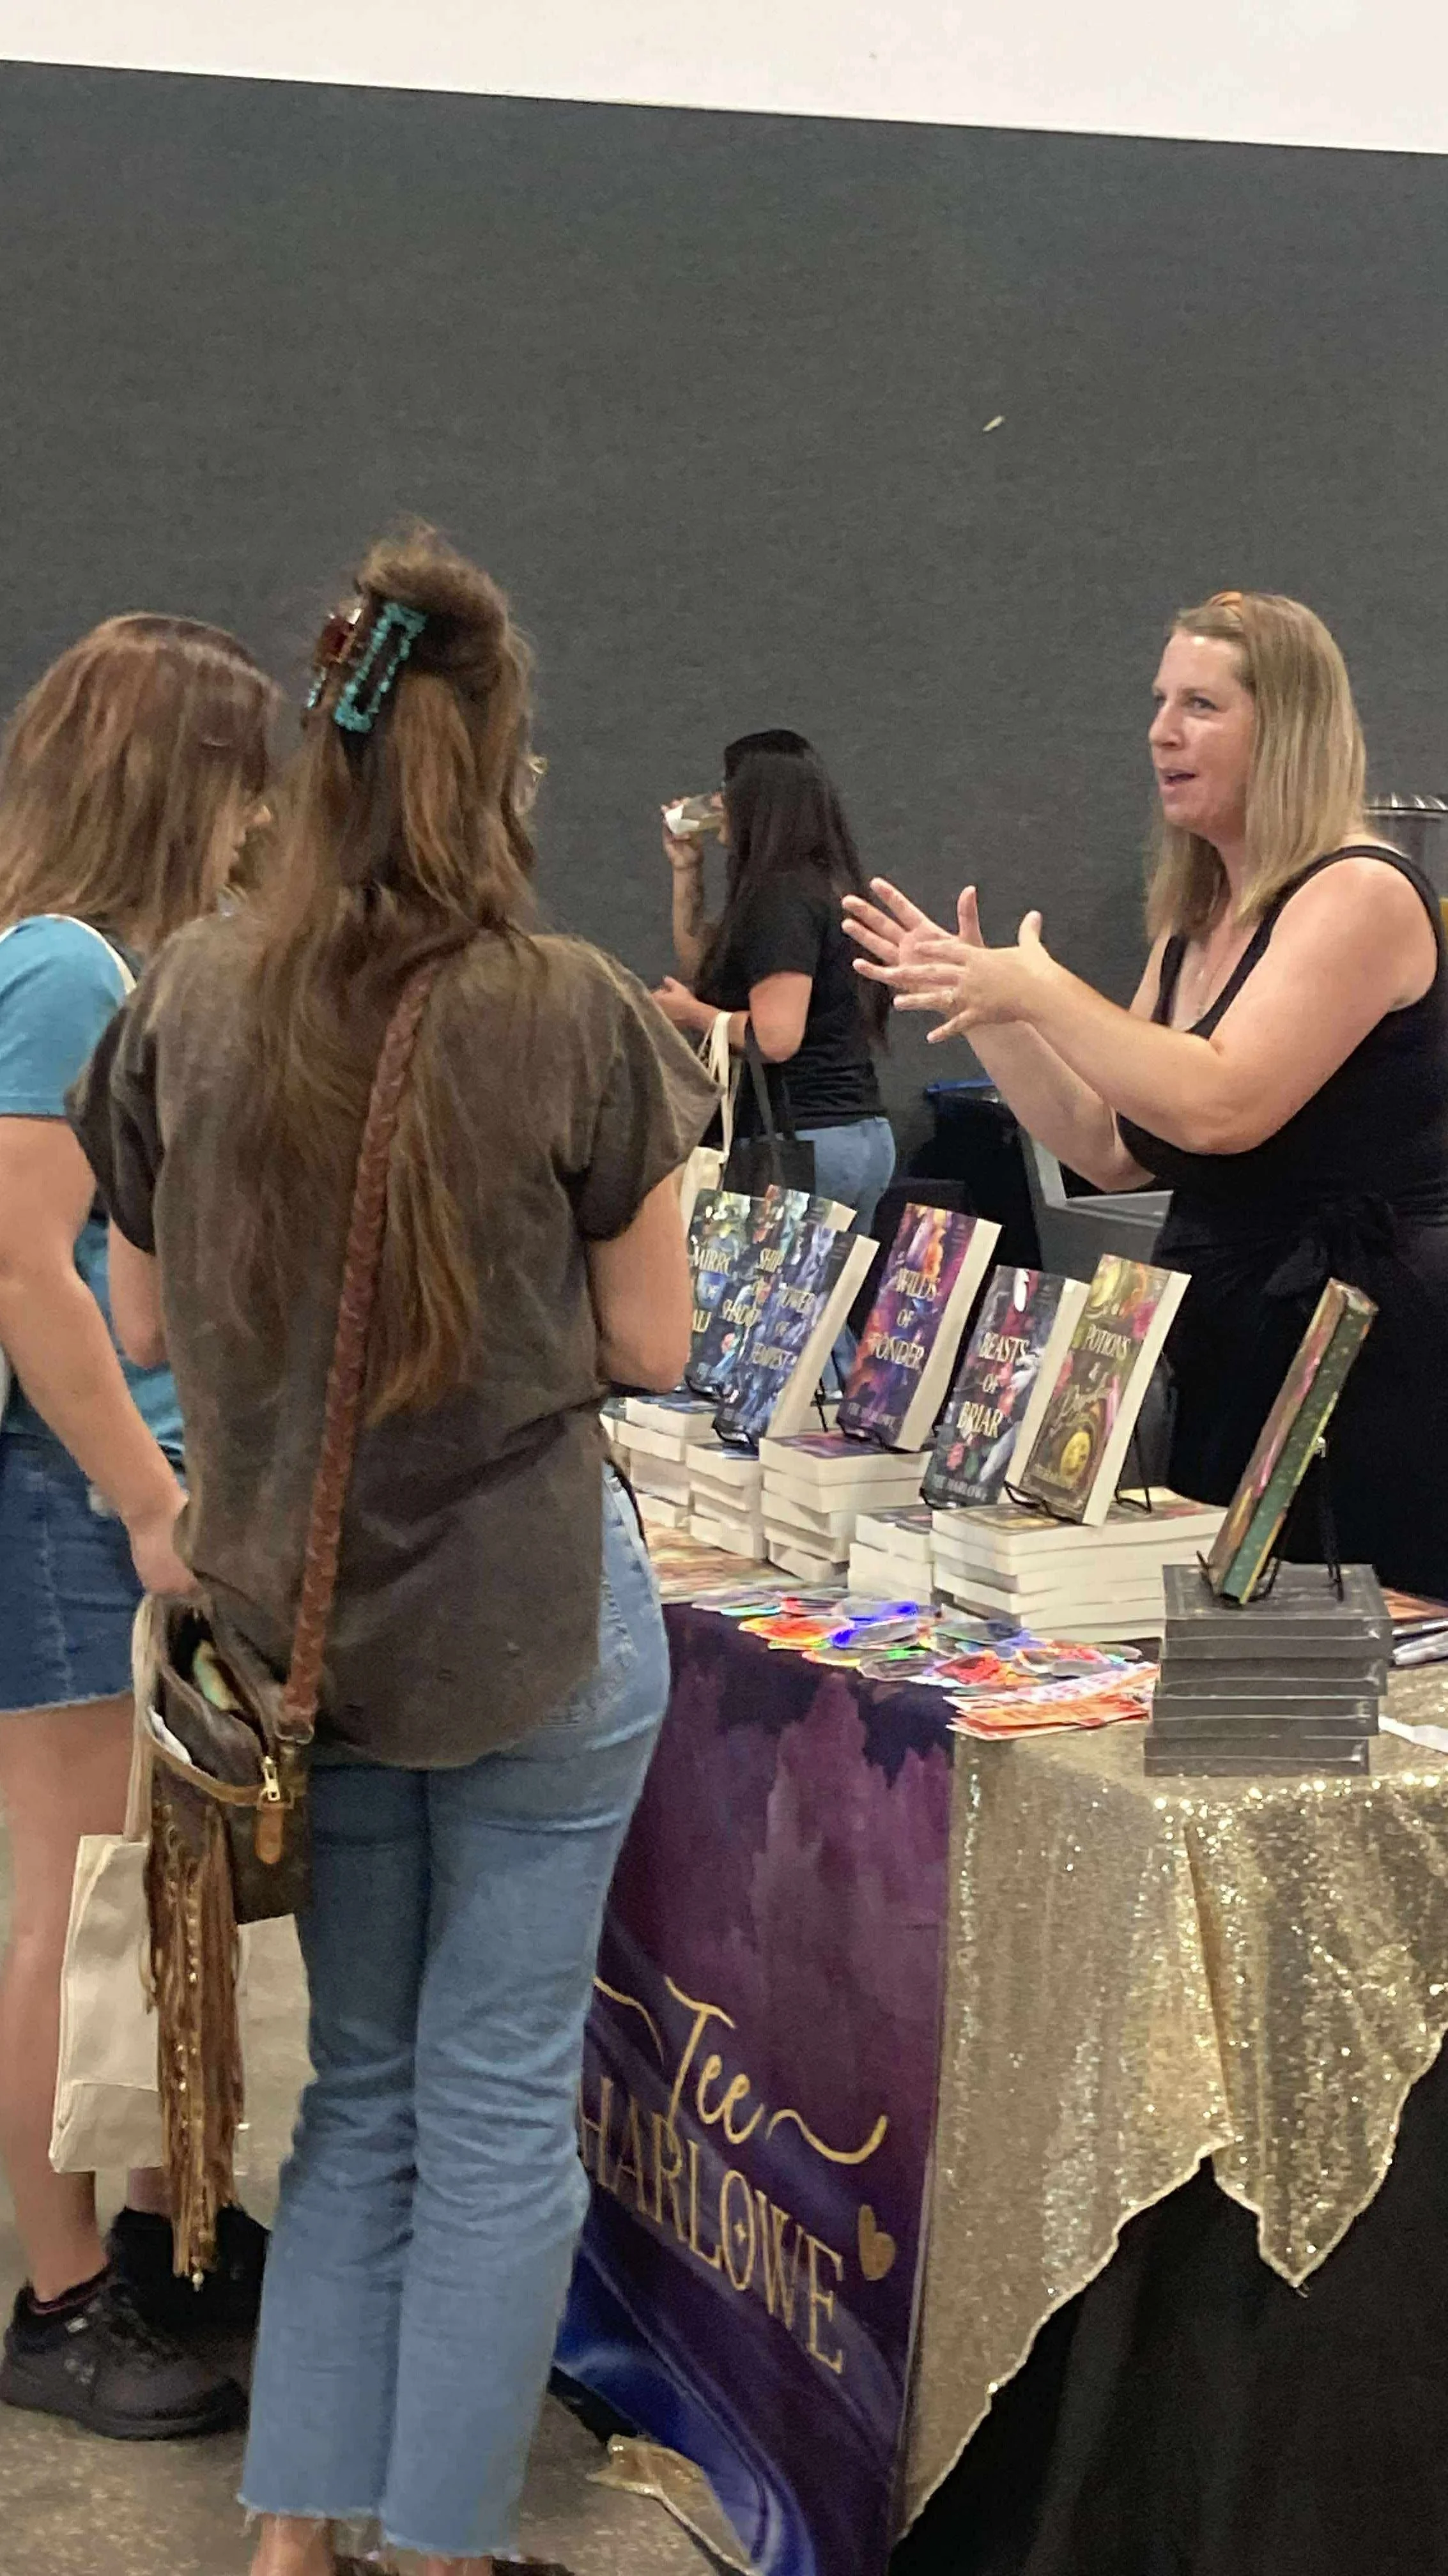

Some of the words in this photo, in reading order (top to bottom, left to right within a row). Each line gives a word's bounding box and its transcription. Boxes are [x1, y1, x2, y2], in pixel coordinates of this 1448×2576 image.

[896, 1268, 939, 1301] WILDS
[897, 1308, 915, 1328] OF
[978, 1331, 1030, 1363] BEASTS
[1082, 1324, 1130, 1360] POTIONS
[982, 1374, 999, 1395] OF
[957, 1400, 1003, 1438] BRIAR
[580, 2075, 843, 2374] HARLOWE
